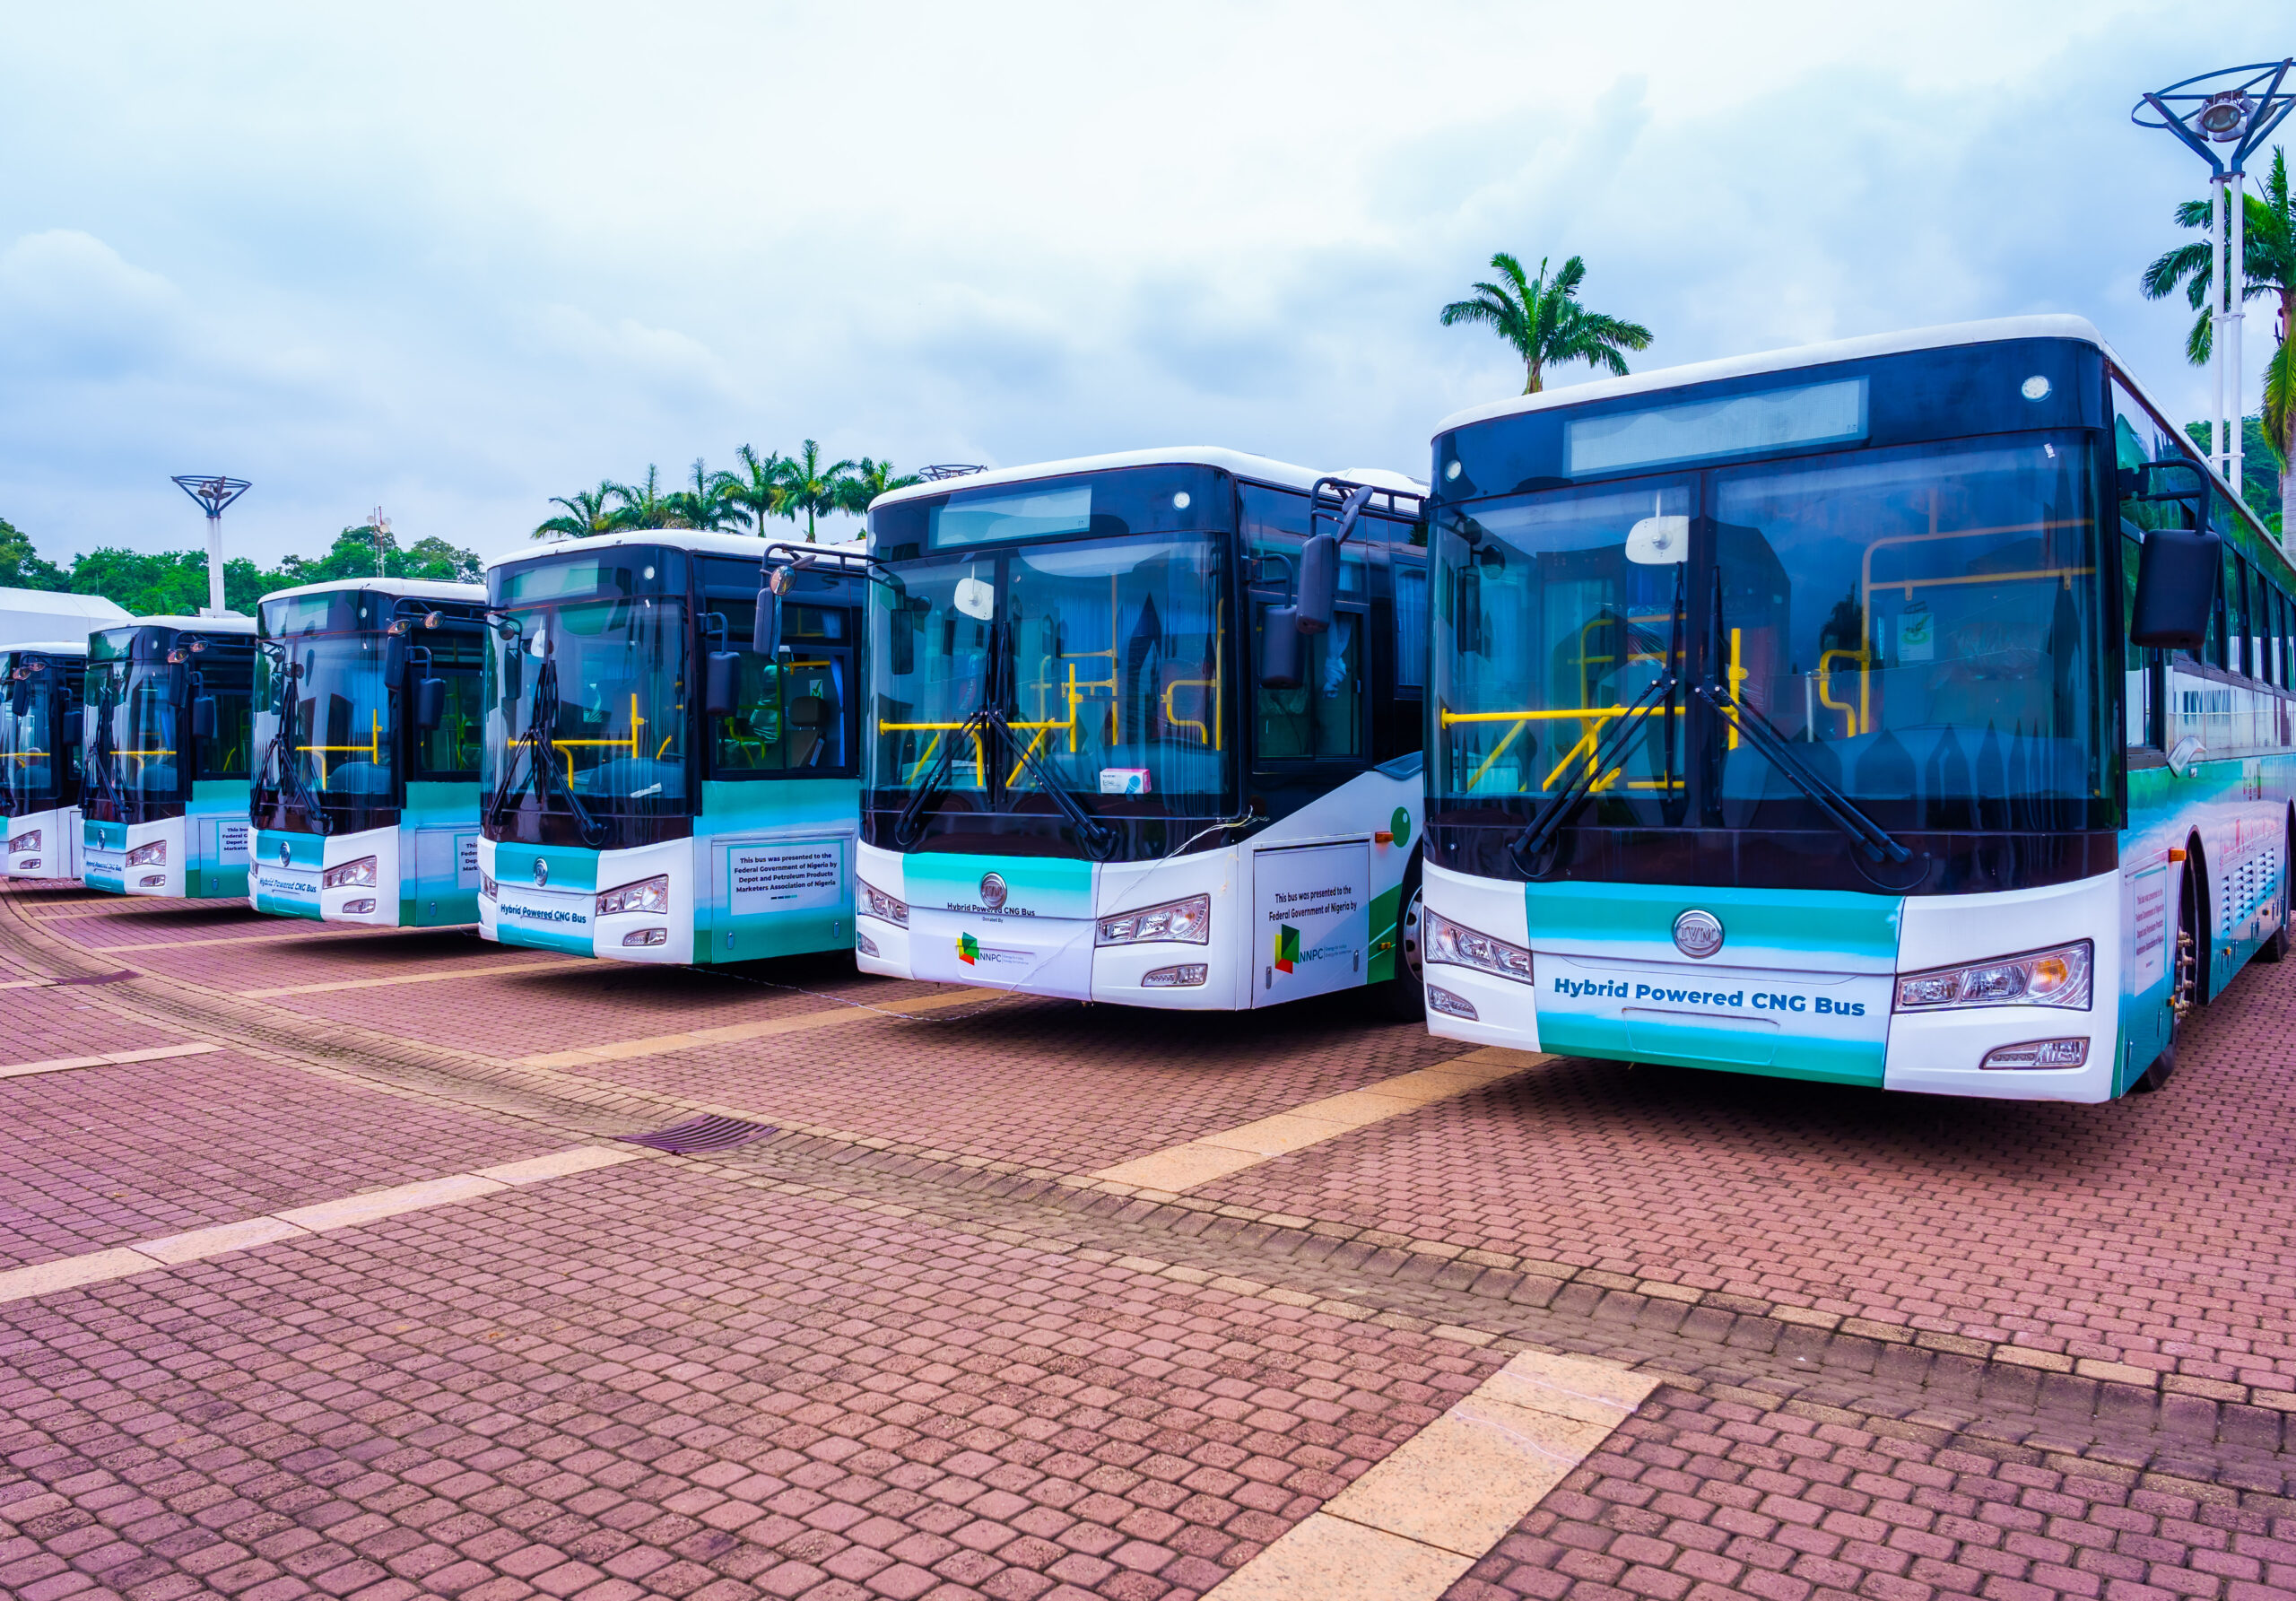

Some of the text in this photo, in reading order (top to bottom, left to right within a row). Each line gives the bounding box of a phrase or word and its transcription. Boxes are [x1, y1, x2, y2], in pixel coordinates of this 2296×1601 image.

[782, 854, 813, 862] presented
[760, 864, 798, 872] Government
[807, 861, 828, 869] Nigeria
[295, 883, 306, 891] CNG
[307, 884, 316, 892] Bus
[770, 882, 805, 890] Association
[815, 879, 836, 887] Nigeria
[1275, 893, 1287, 903] This
[1288, 892, 1297, 902] bus
[1298, 892, 1309, 900] was
[1310, 887, 1336, 901] presented
[1343, 885, 1351, 894] the
[501, 904, 586, 923] Hybrid Powered CNG Bus
[947, 902, 971, 911] Hybrid
[972, 905, 1002, 914] Powered
[1269, 901, 1357, 921] Federal Government of Nigeria by
[1680, 926, 1716, 943] IVM
[980, 953, 1001, 962] NNPC
[1300, 948, 1323, 963] NNPC
[1554, 978, 1866, 1017] Hybrid Powered CNG Bus
